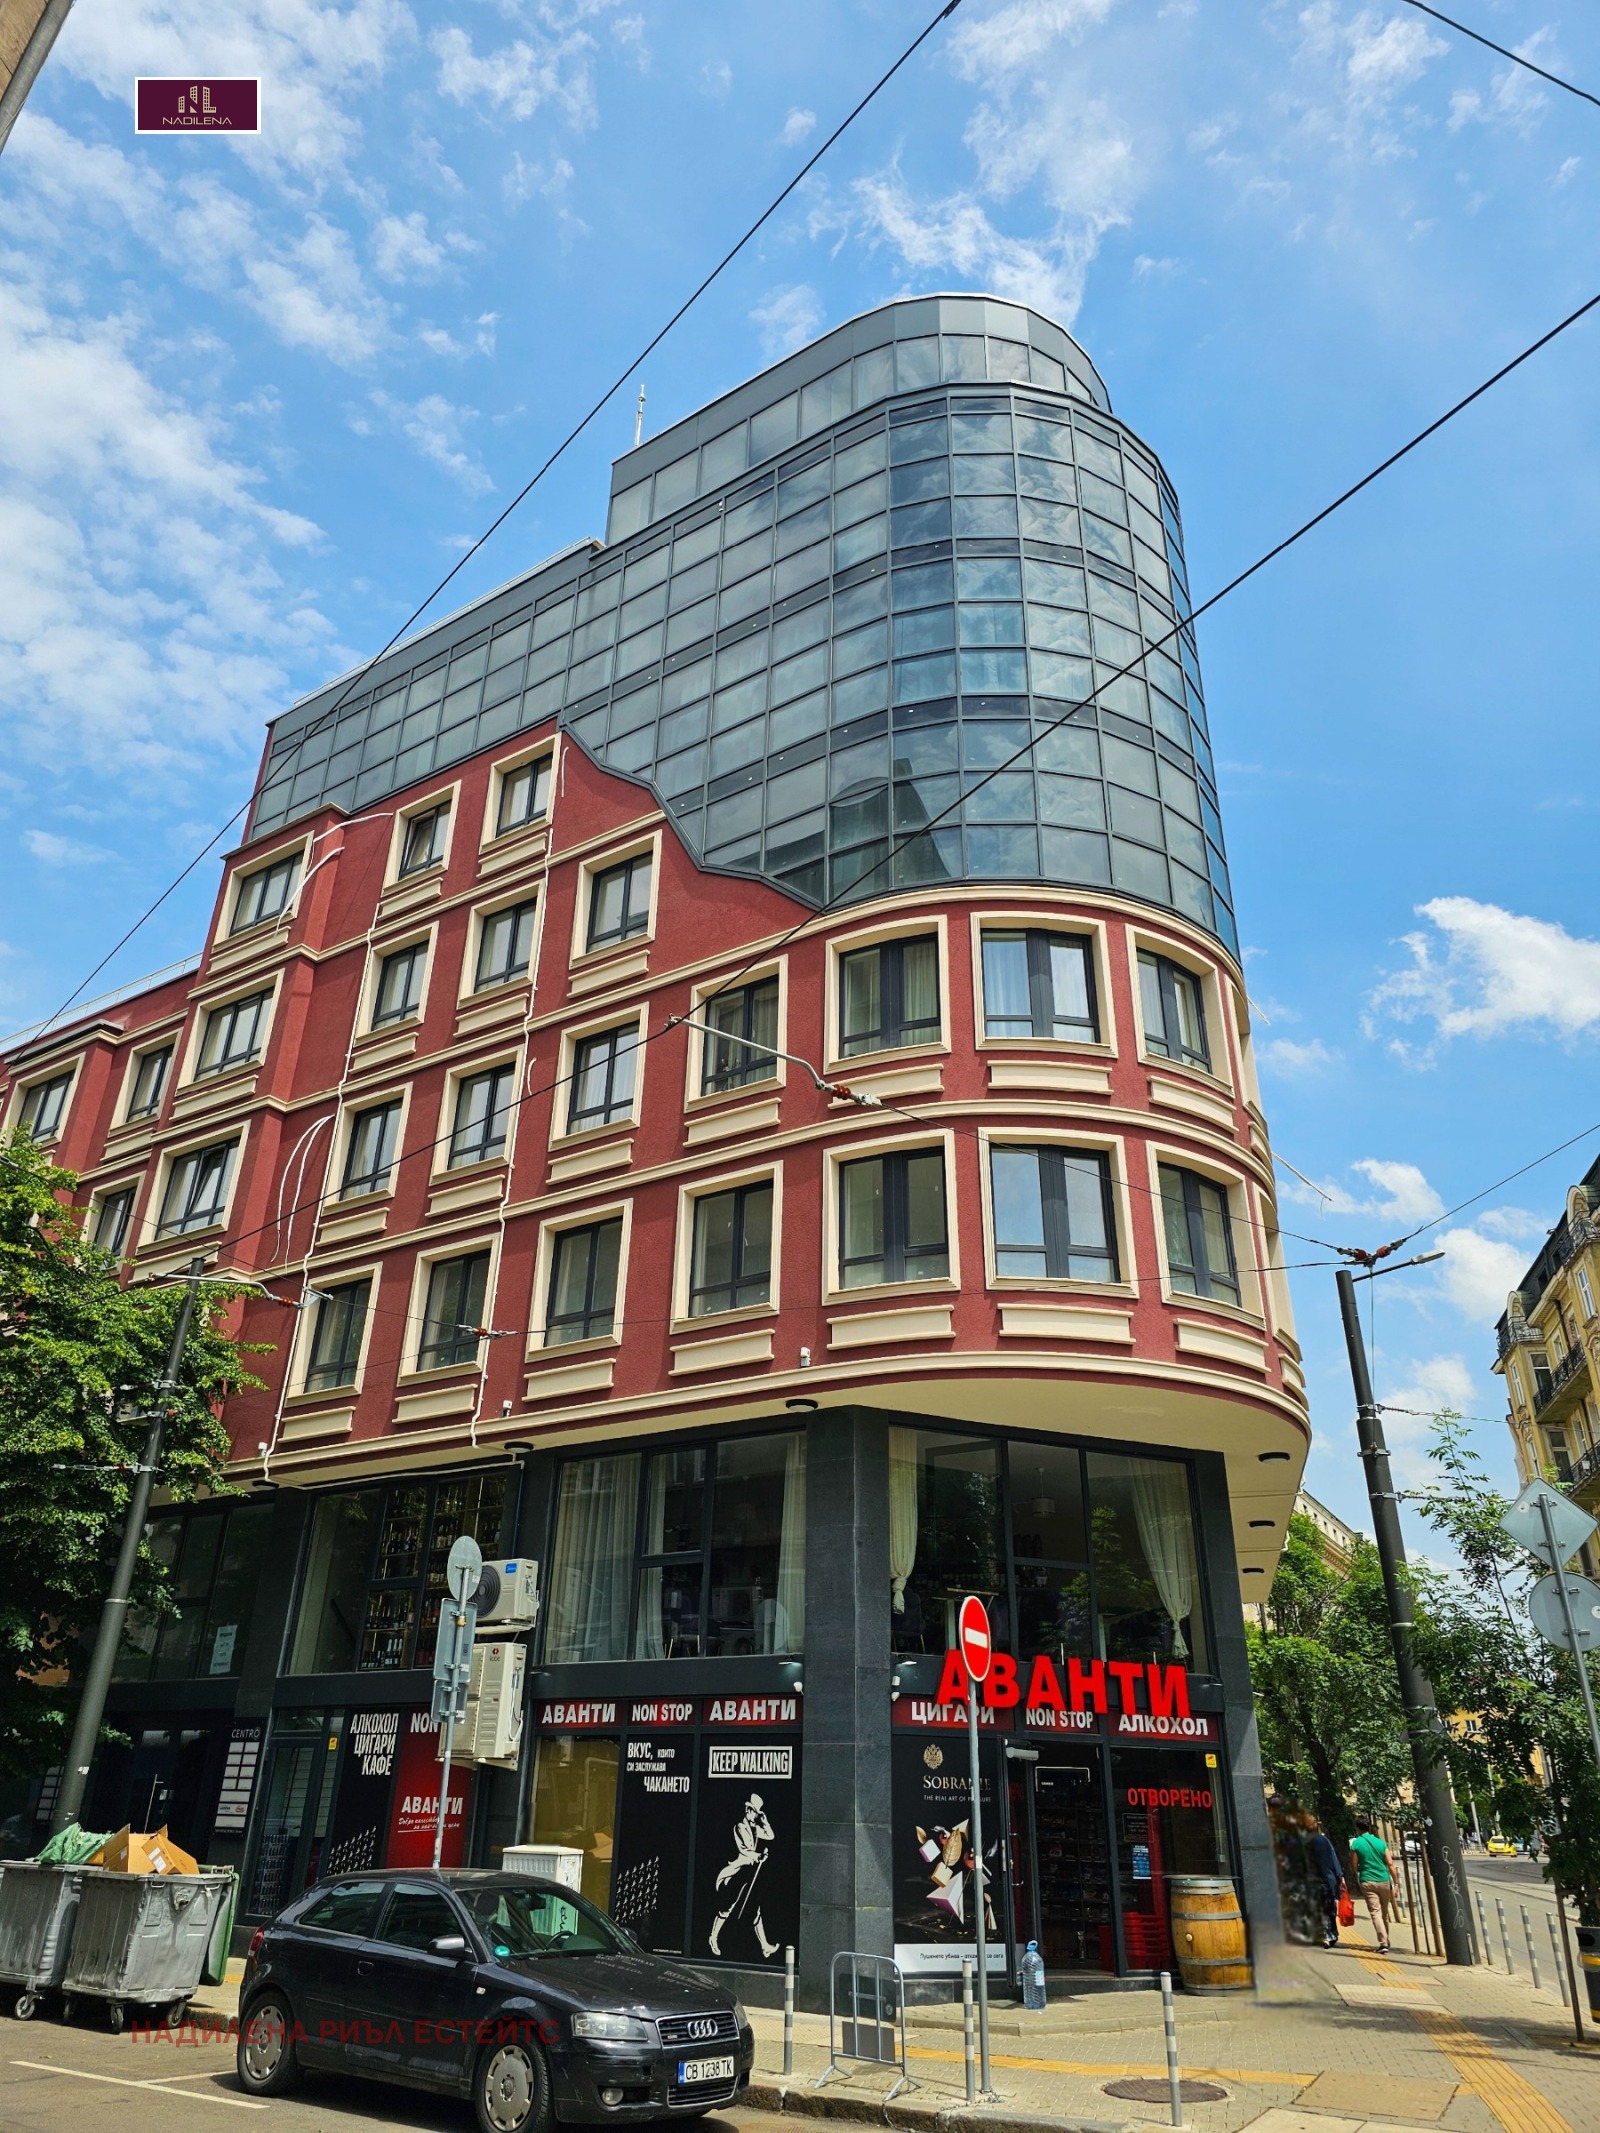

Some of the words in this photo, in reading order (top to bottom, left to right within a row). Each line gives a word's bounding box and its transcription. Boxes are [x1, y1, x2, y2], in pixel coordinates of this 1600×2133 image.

[936, 1649, 1191, 1718] АВАНТИ
[542, 1703, 616, 1724] АВАНТИ
[631, 1704, 658, 1721] NON
[661, 1703, 693, 1721] STOP
[709, 1699, 796, 1721] АВАНТИ
[1026, 1708, 1055, 1726] NON
[1059, 1710, 1093, 1729] STOP
[350, 1713, 399, 1734] АЛКОХОЛ
[410, 1712, 438, 1733] NON
[1118, 1714, 1208, 1736] АЛКОХОЛ
[231, 1728, 260, 1739] CENTRO
[354, 1734, 396, 1757] ЦИГАРИ
[627, 1742, 653, 1760] ВКУС,
[362, 1755, 392, 1776] КАФЕ
[712, 1752, 737, 1773] KEEP
[739, 1751, 789, 1773] WALKING
[643, 1776, 690, 1793] ЧАКАНЕТО
[1127, 1787, 1214, 1808] ОТВОРЕНО
[685, 2064, 698, 2080] CB
[721, 2060, 732, 2075] TK
